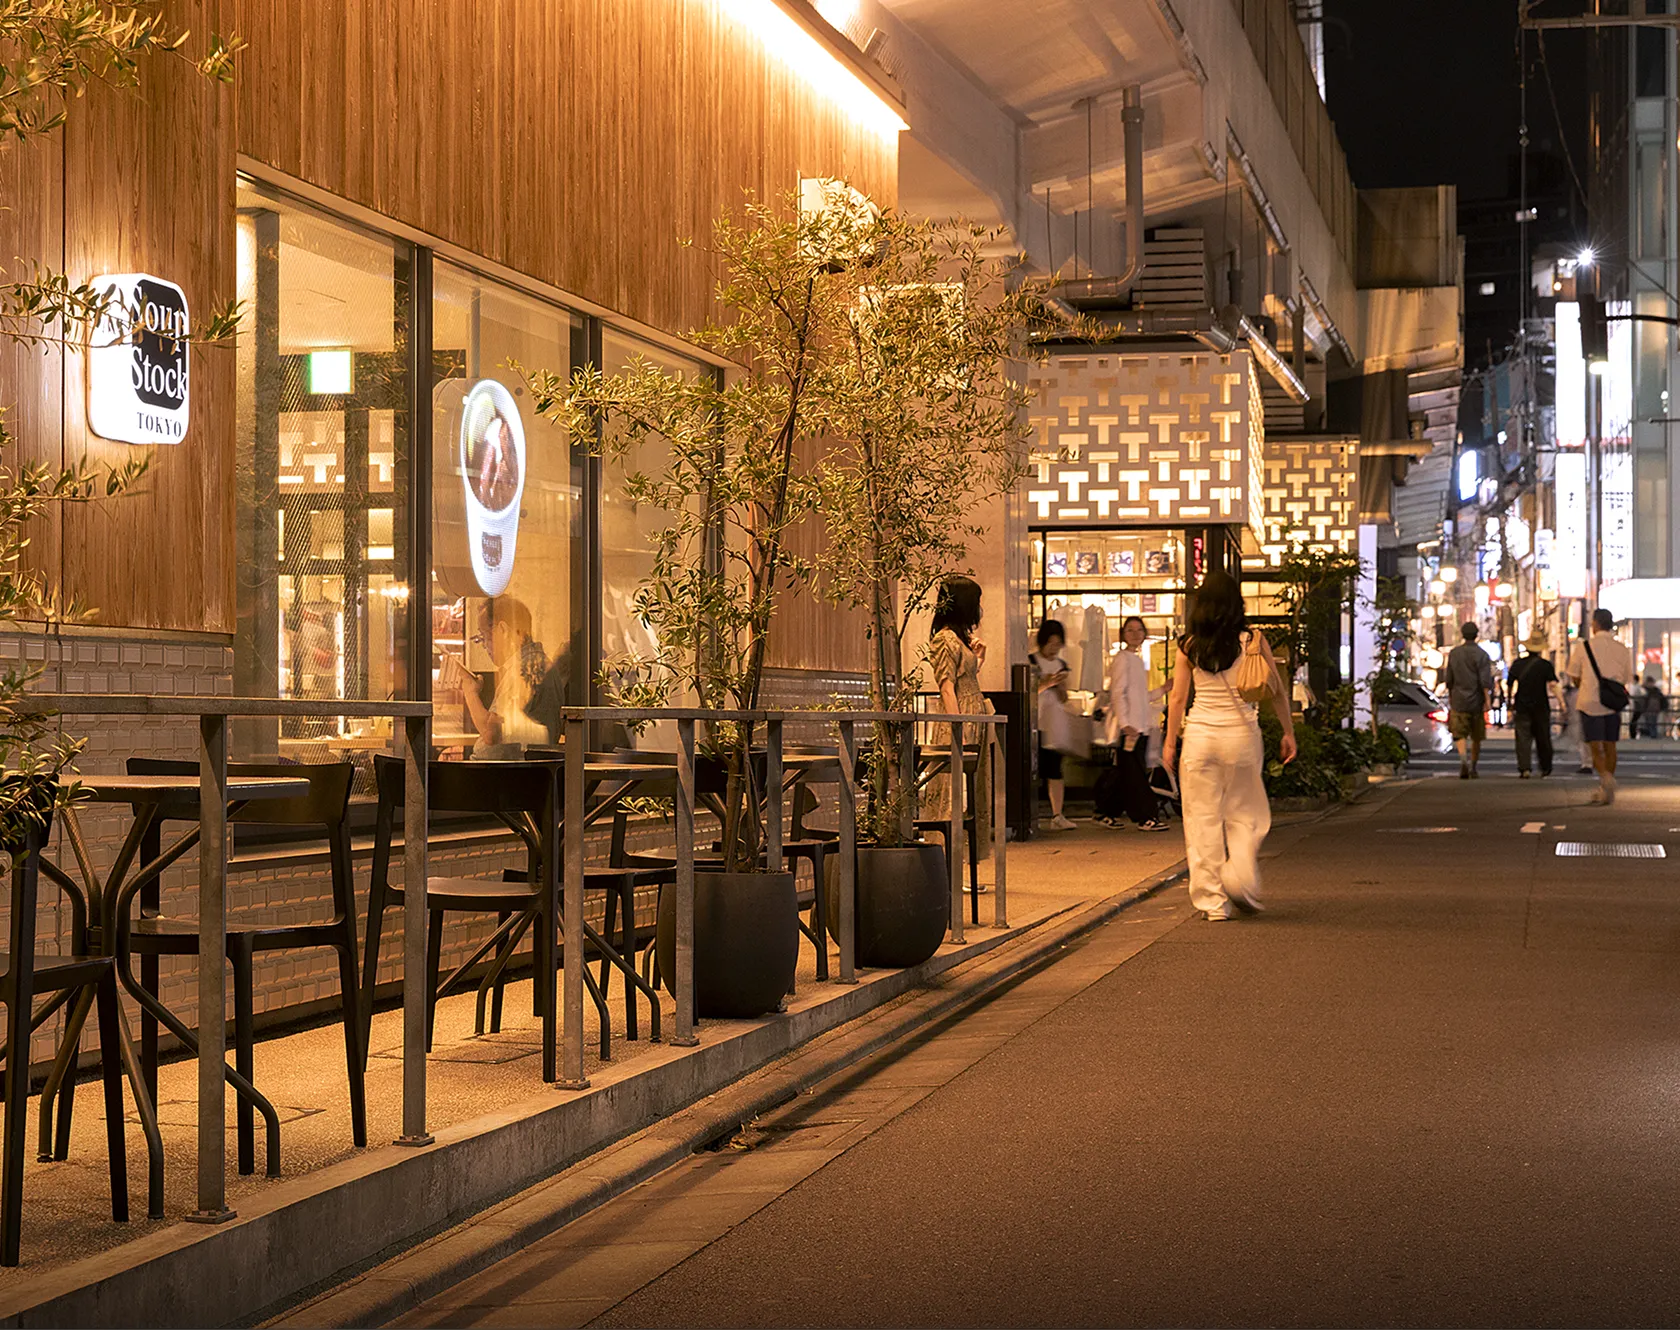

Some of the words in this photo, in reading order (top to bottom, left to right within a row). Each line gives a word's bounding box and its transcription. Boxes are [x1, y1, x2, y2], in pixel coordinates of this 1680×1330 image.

[133, 286, 186, 352] Soup
[132, 346, 187, 400] Stock
[137, 412, 182, 437] TOKYO
